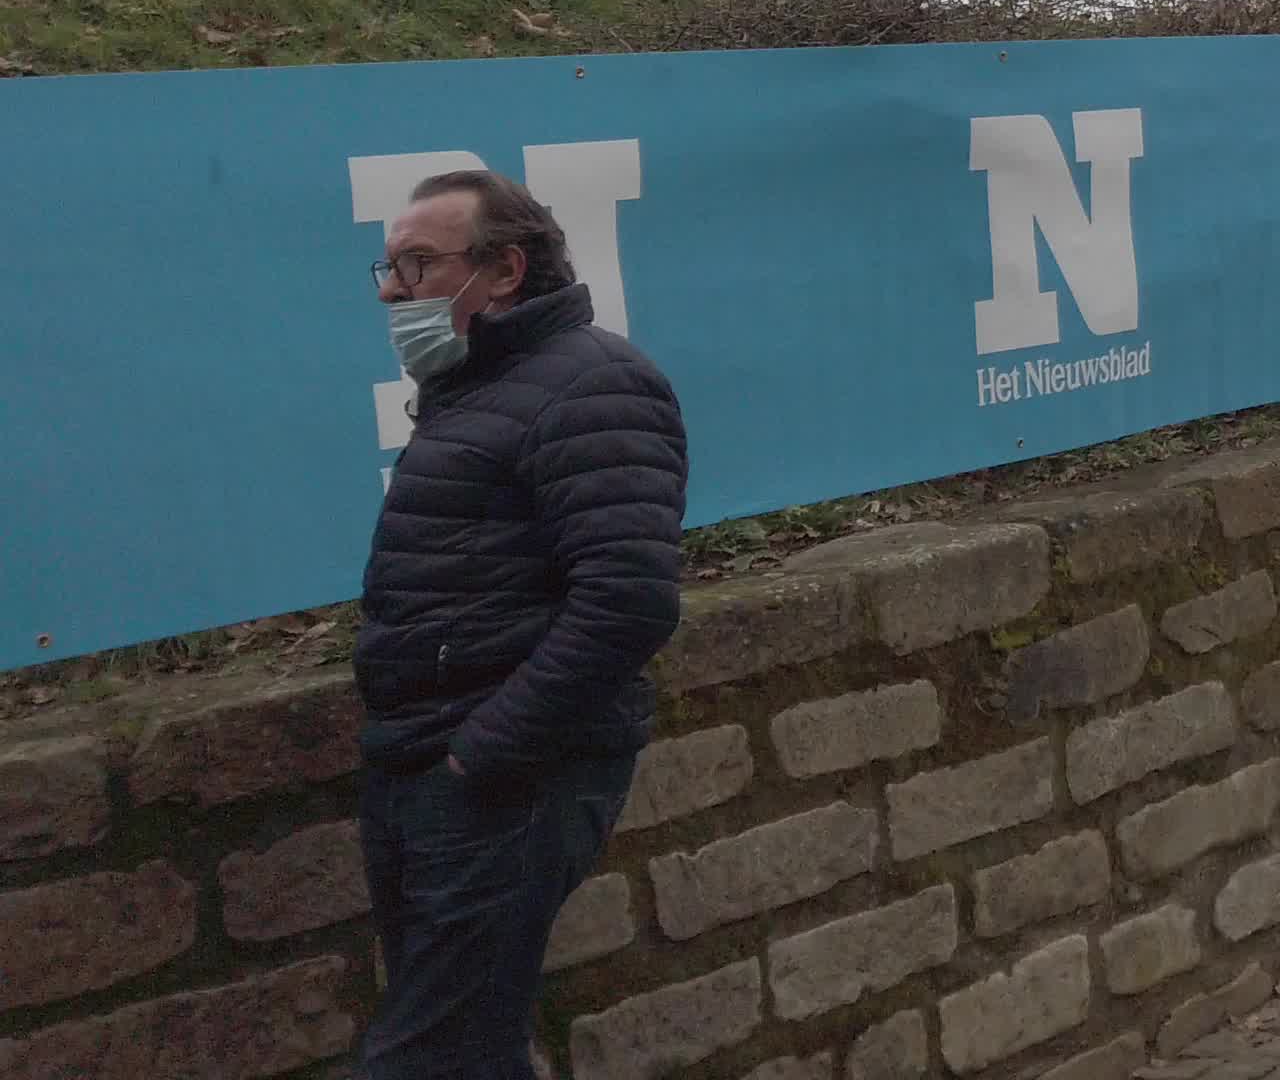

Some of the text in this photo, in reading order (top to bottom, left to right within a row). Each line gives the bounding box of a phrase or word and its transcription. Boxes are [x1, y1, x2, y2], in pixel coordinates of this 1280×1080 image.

[969, 107, 1144, 355] N
[976, 340, 1152, 407] Het Nieuwsblad
